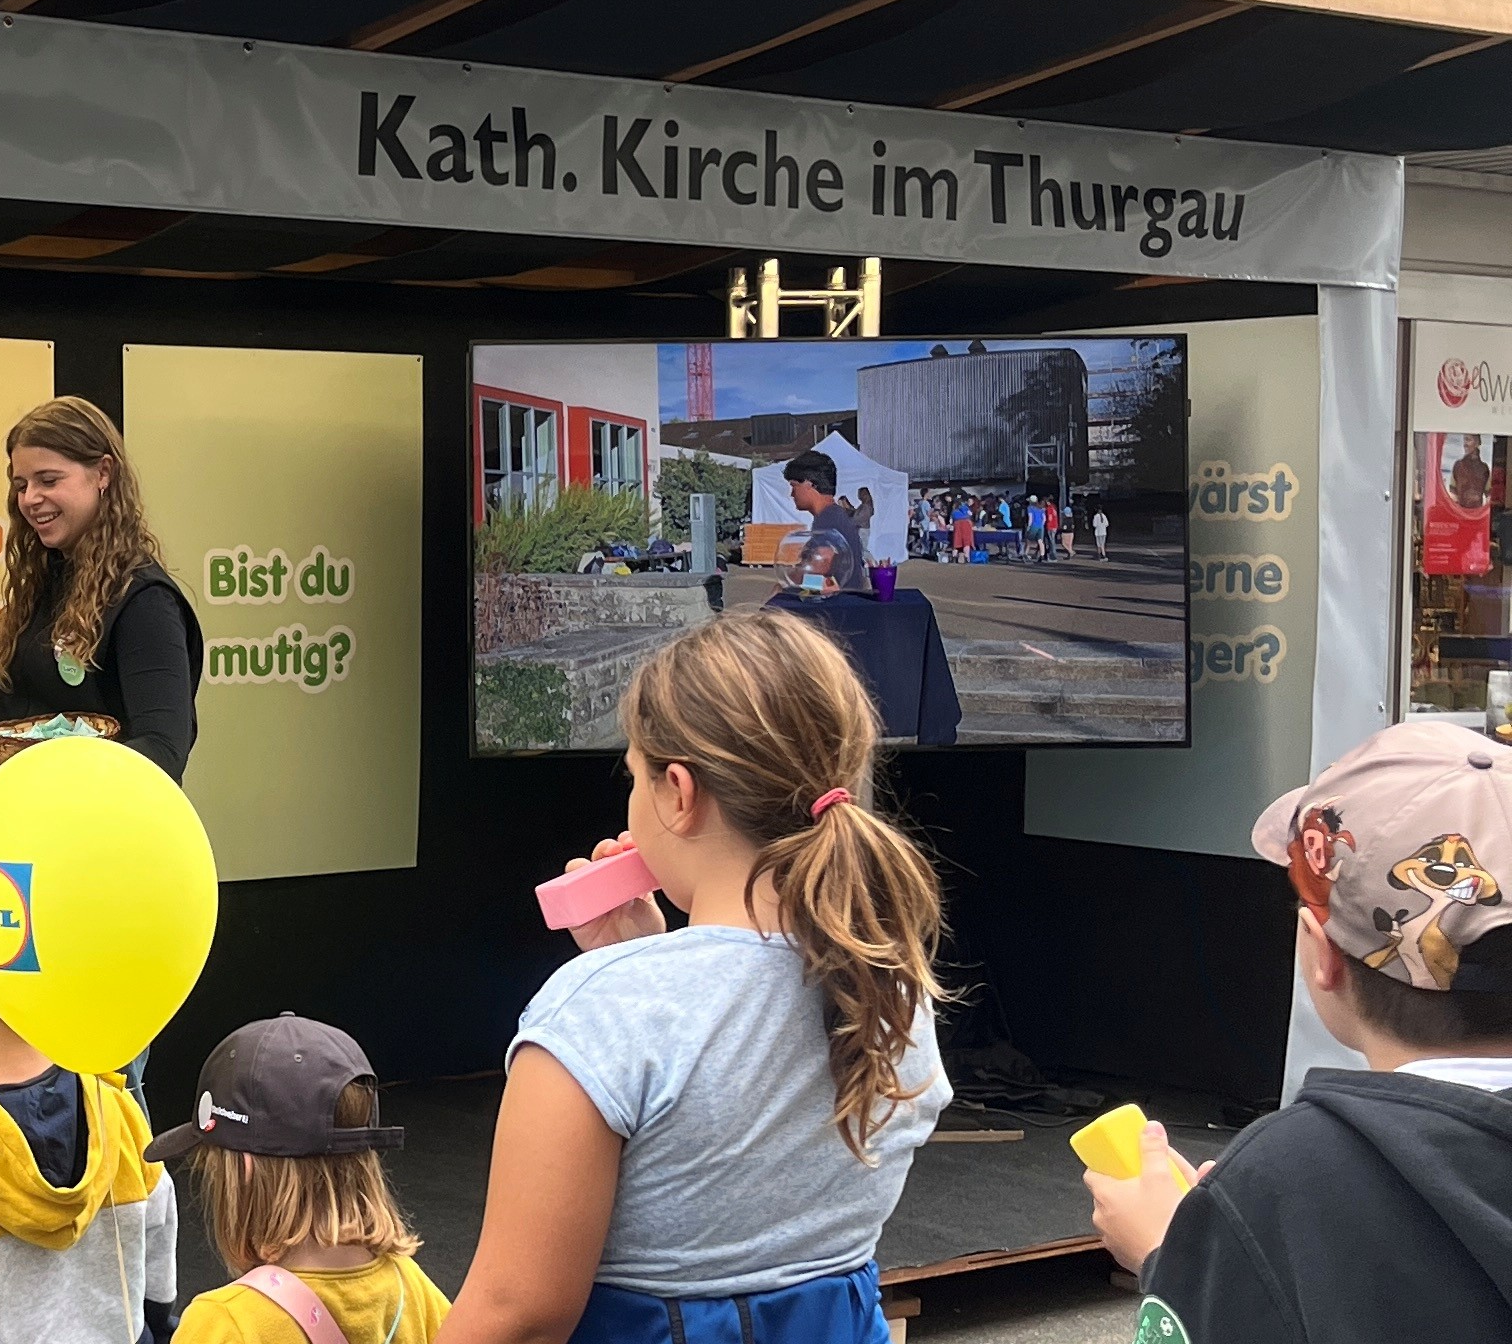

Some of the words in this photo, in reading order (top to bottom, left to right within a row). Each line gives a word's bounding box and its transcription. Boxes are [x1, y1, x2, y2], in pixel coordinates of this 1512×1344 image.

[358, 90, 578, 193] Kath.
[602, 114, 844, 213] Kirche
[872, 139, 959, 222] im
[973, 149, 1246, 258] Thurgau
[209, 551, 288, 598] Bist
[299, 551, 350, 598] du
[209, 629, 352, 687] mutig?
